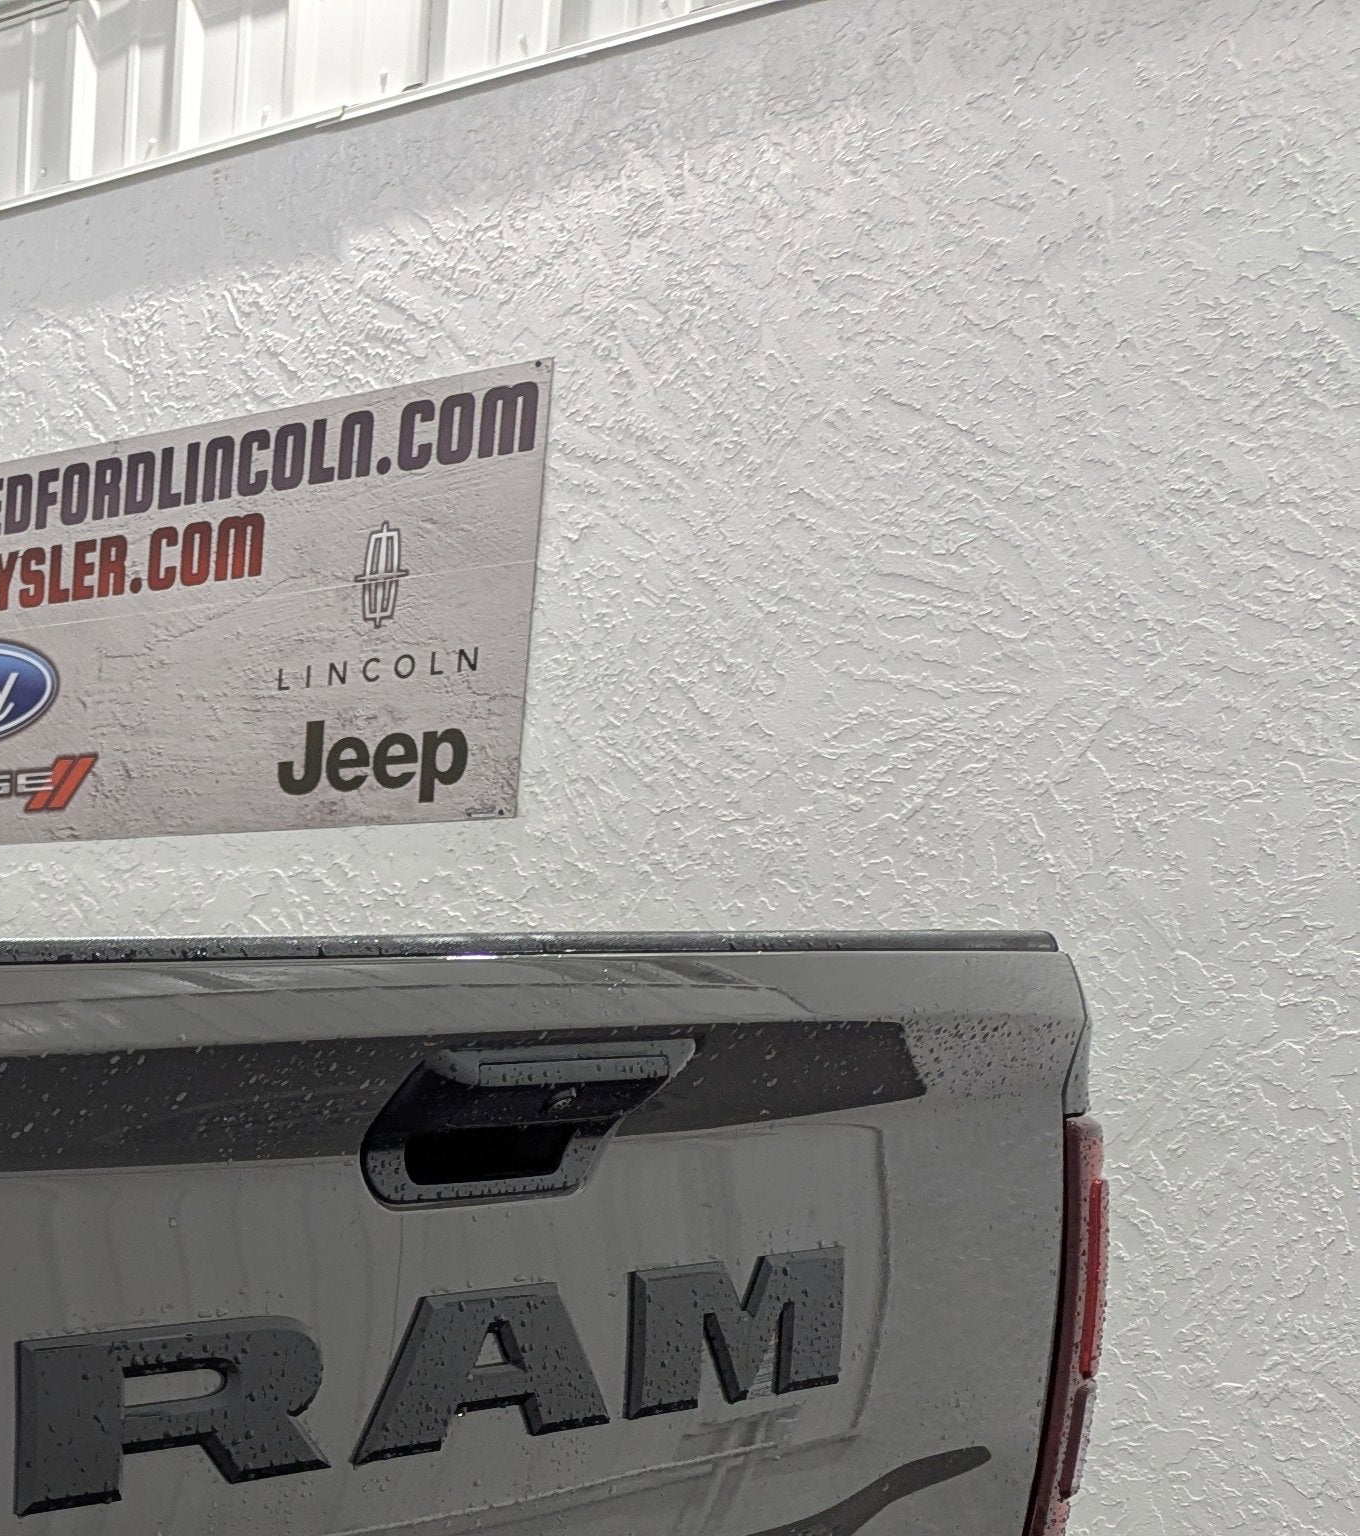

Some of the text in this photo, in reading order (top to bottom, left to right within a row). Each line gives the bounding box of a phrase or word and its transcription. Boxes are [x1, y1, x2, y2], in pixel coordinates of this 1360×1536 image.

[278, 647, 479, 691] LINCOLN
[278, 719, 468, 803] Jeep
[13, 1245, 845, 1518] RAM
